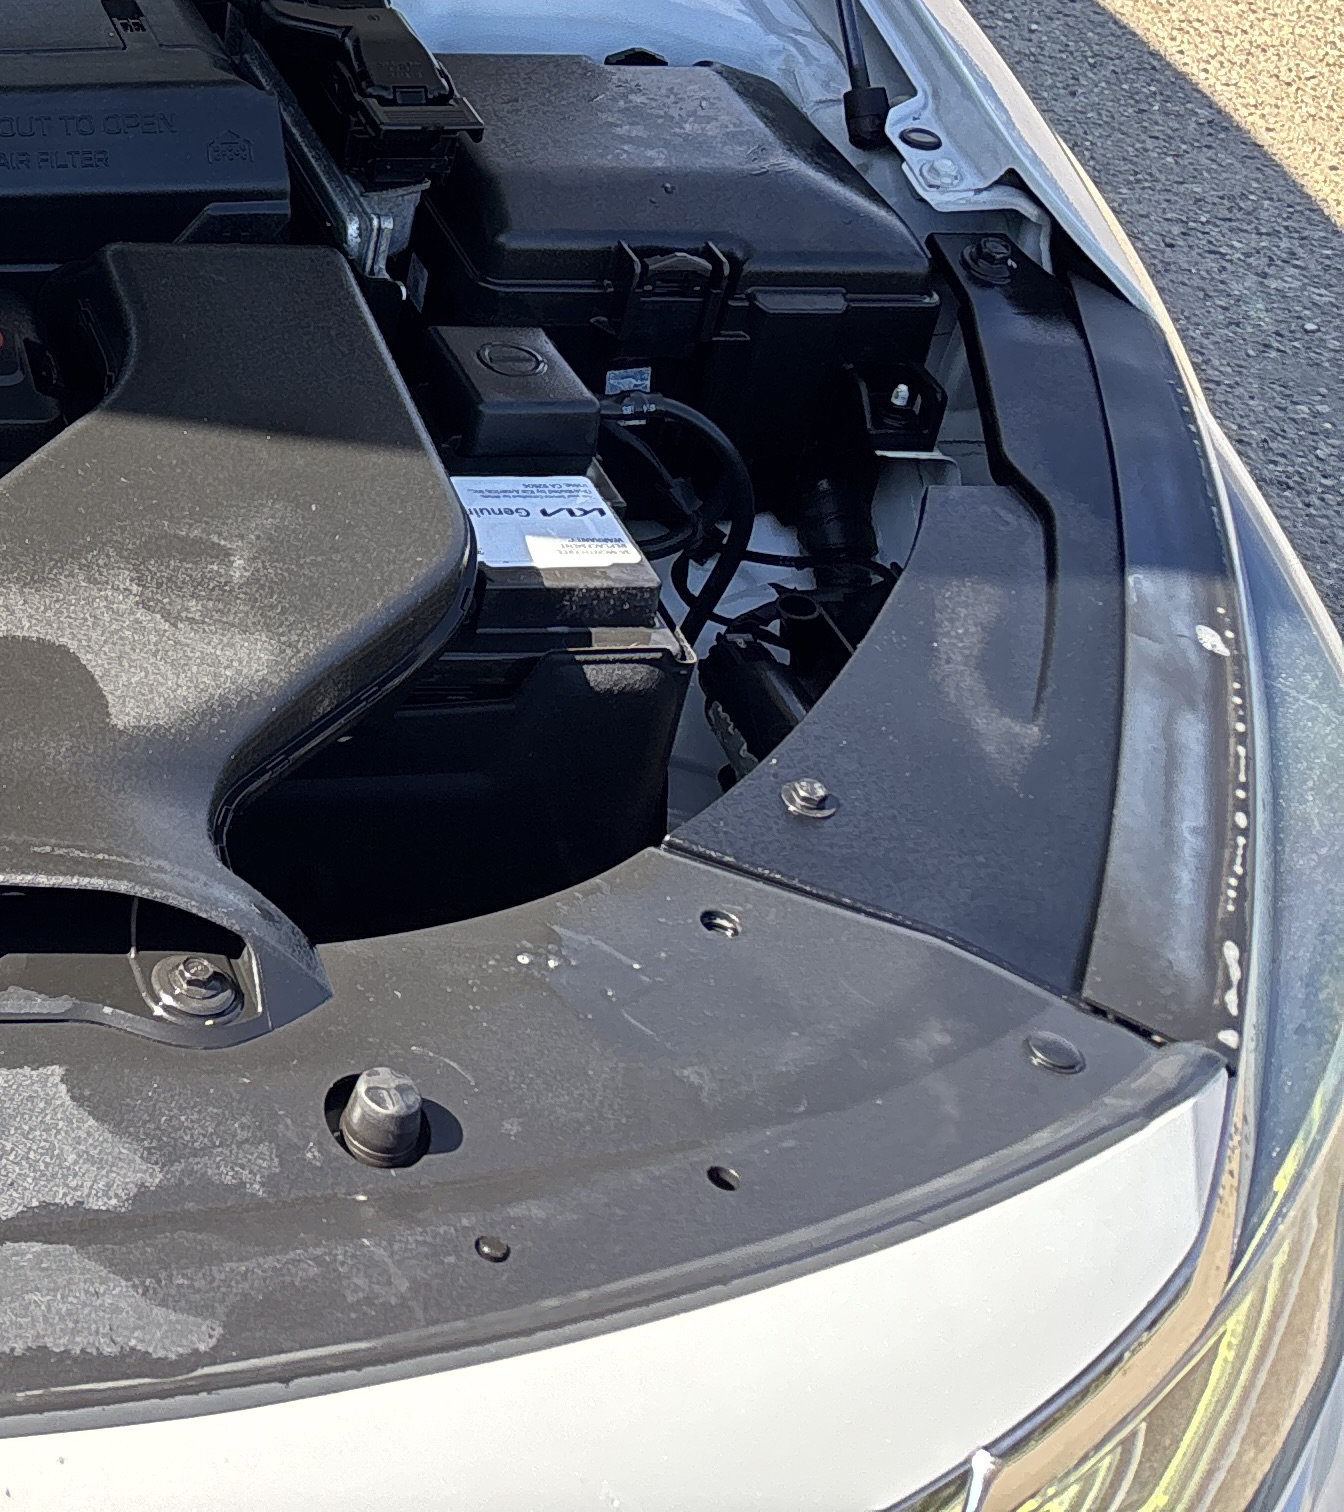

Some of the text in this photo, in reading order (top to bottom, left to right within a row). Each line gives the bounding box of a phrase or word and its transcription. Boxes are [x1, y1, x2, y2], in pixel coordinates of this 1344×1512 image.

[58, 115, 96, 136] TO
[102, 112, 178, 135] OPEN
[37, 149, 110, 169] FILTER
